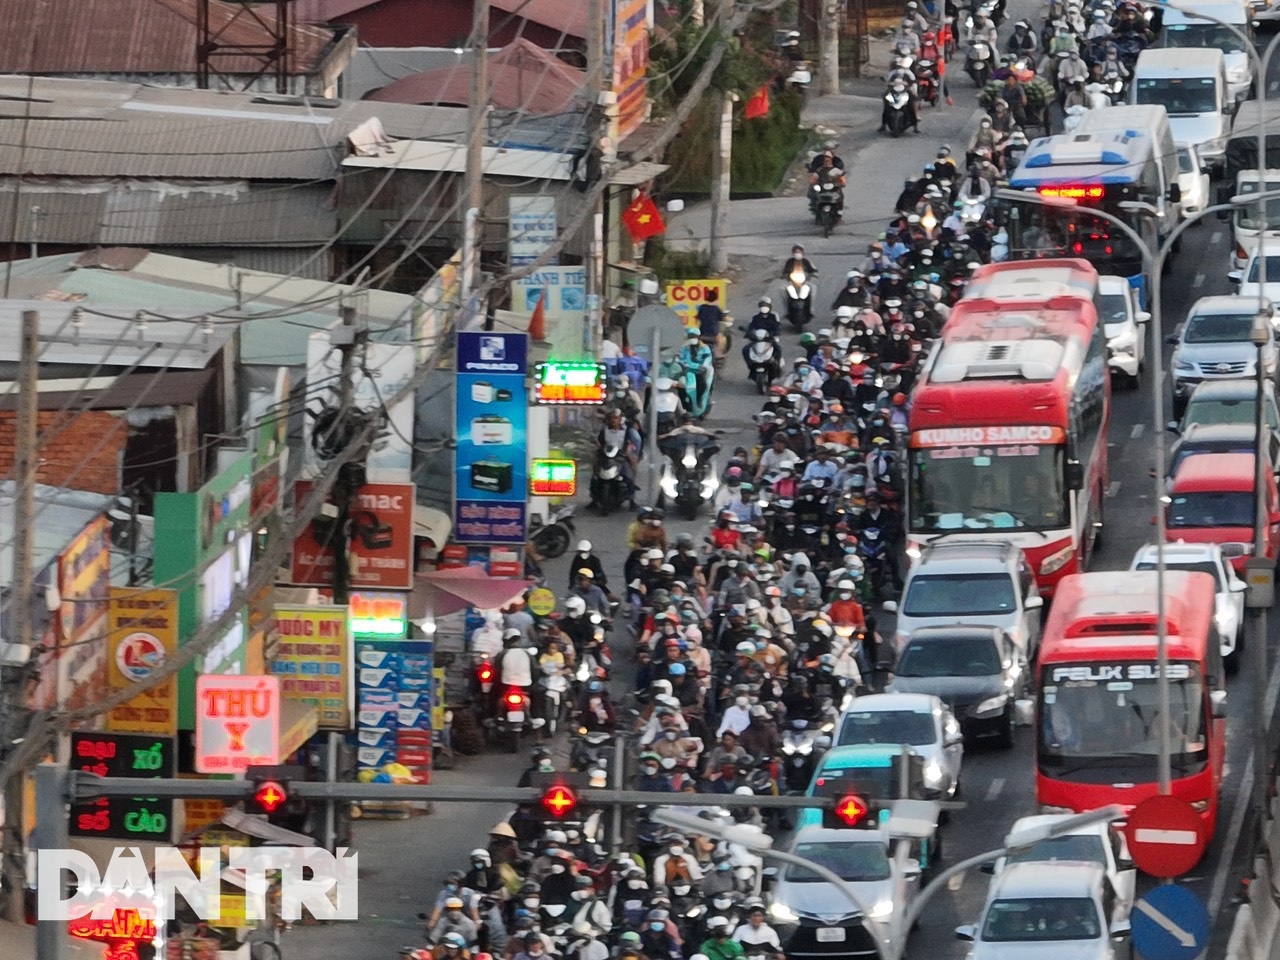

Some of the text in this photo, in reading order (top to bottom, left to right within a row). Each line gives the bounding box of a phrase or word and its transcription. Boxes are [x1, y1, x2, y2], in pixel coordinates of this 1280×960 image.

[920, 426, 1052, 444] KUMHO SAMCO
[1054, 666, 1123, 681] FELIX
[203, 681, 272, 717] THÚ
[224, 722, 249, 751] Y
